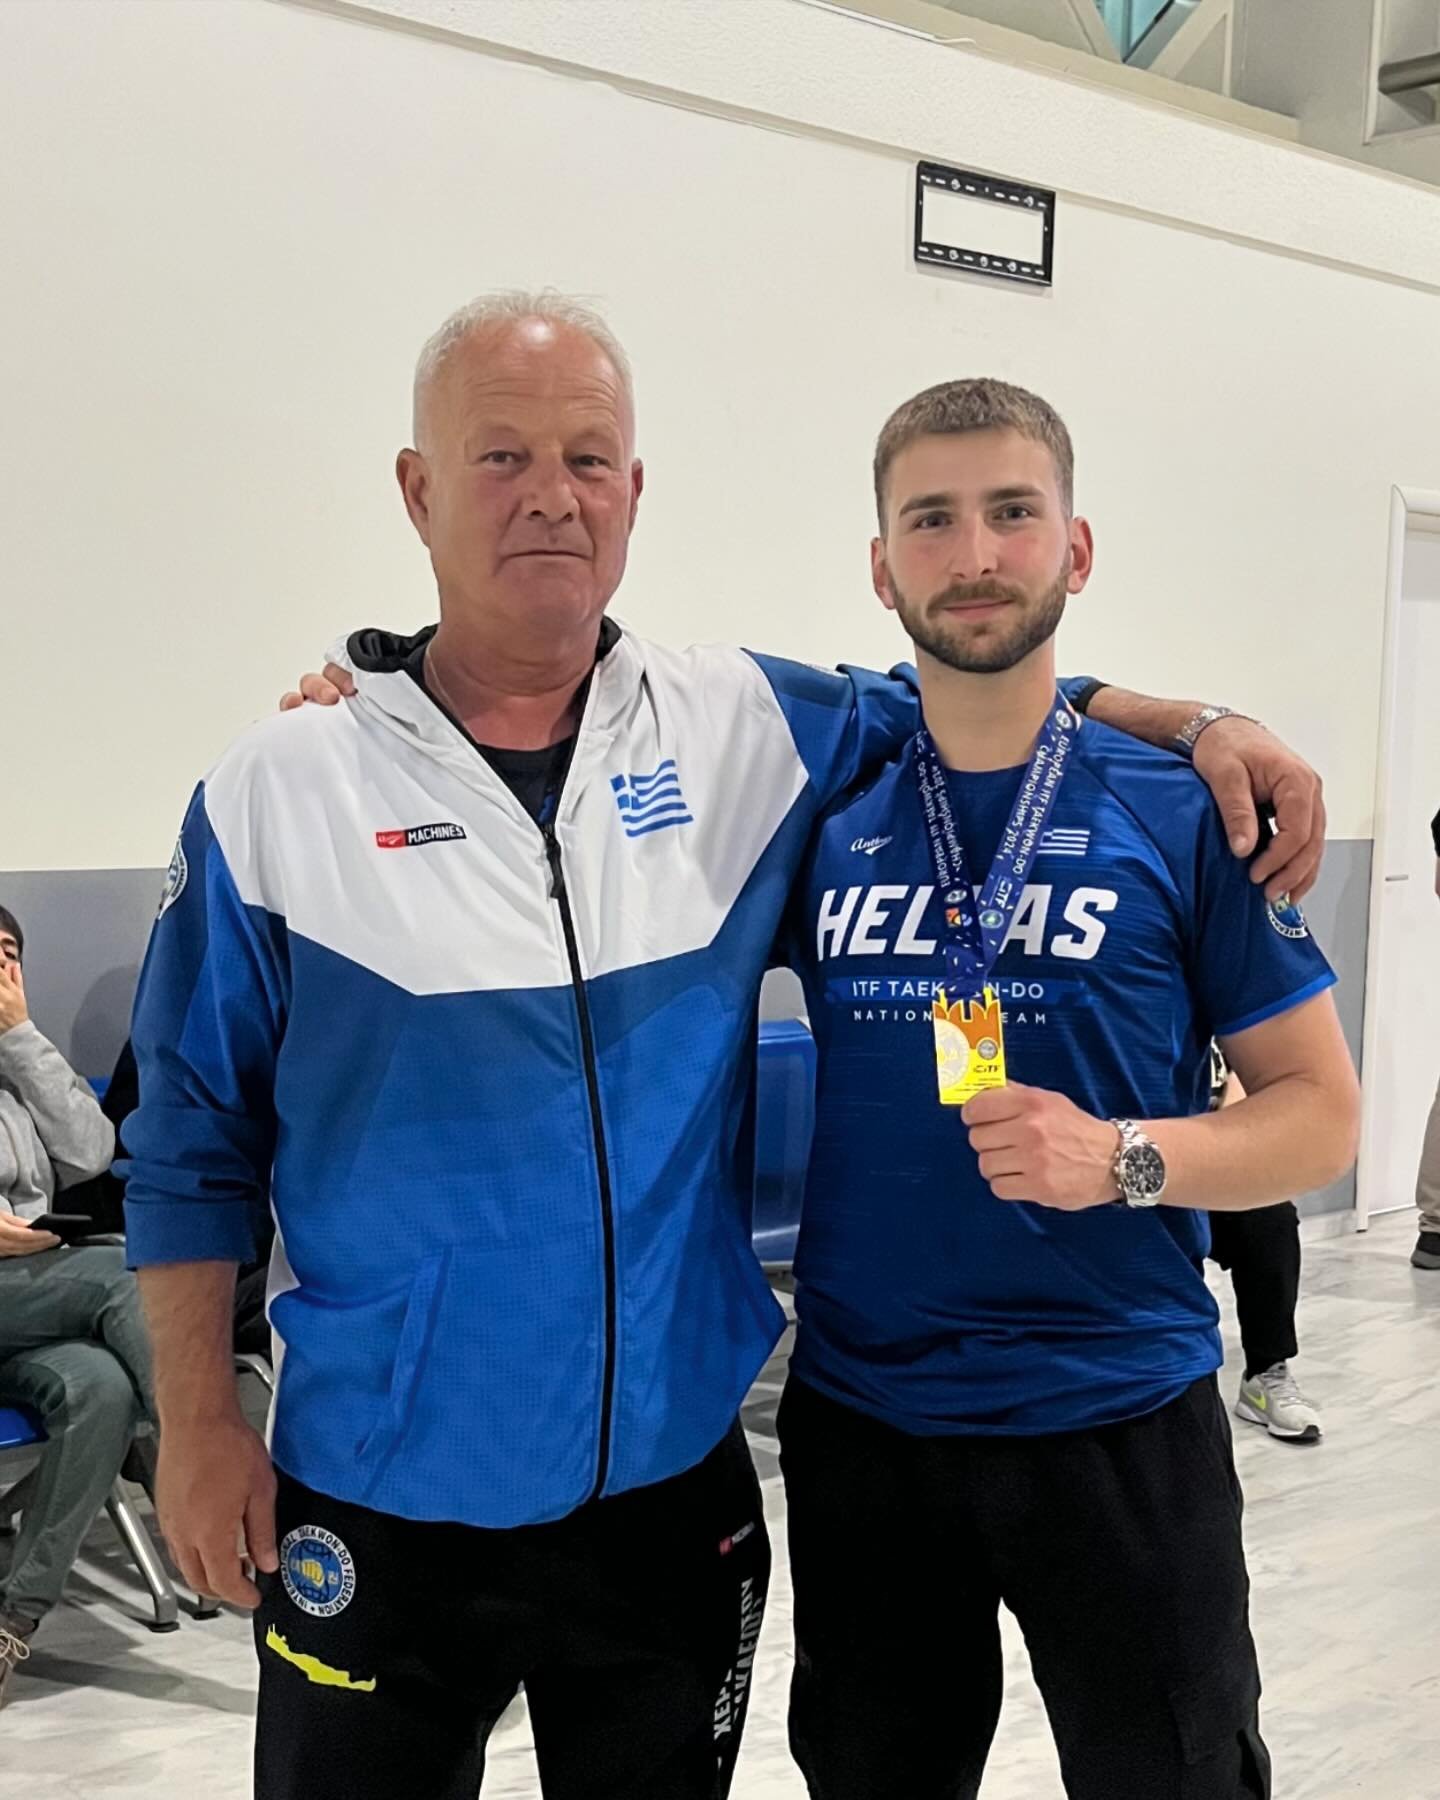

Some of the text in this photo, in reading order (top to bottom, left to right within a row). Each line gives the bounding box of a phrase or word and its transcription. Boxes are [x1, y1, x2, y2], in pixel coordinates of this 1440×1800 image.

[1003, 745, 1050, 854] CHAMPIONSHIPS 2024
[1012, 735, 1070, 874] EUROPEAN ITF TAEKWON-DO
[407, 825, 464, 844] MACHINES
[816, 885, 1119, 962] HELAS
[852, 981, 1044, 998] ITF TAEKN-DO
[853, 1009, 1047, 1025] NATION EAM
